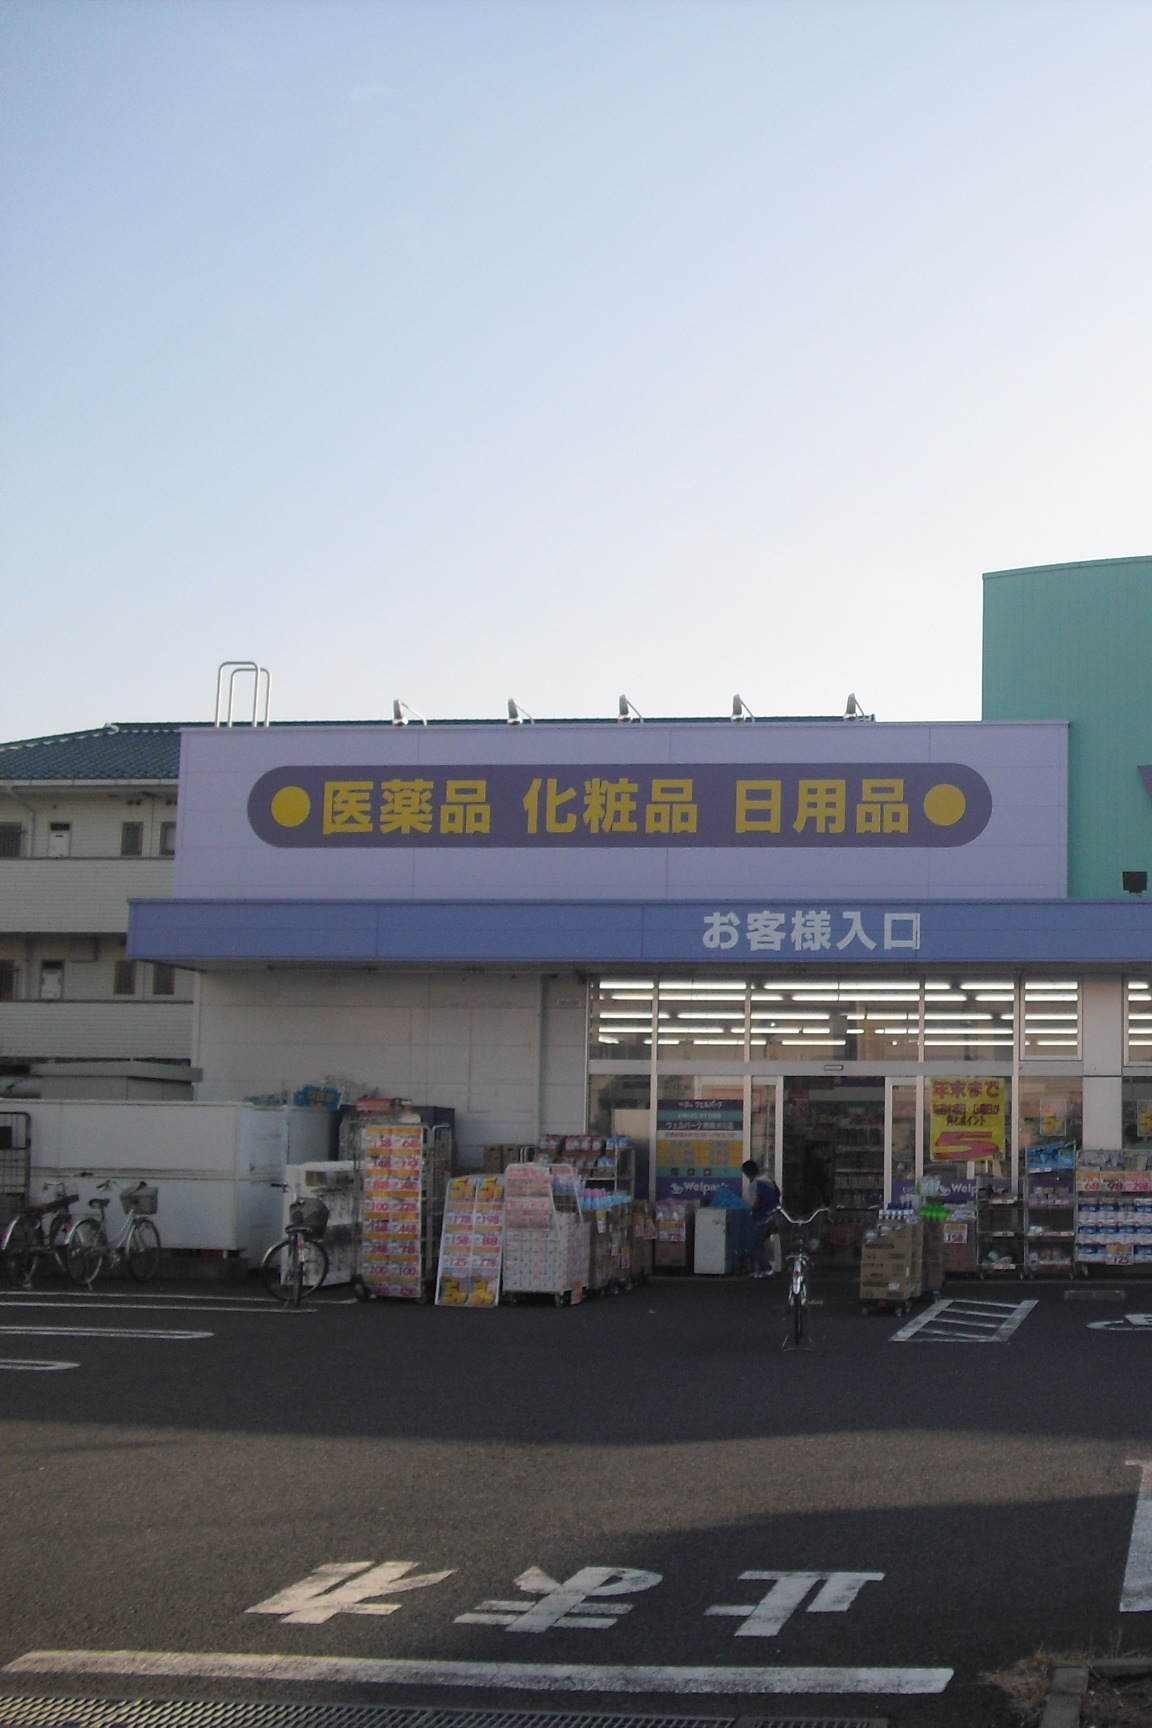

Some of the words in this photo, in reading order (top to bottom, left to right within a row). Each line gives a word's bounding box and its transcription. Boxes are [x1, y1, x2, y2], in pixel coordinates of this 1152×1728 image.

[321, 779, 490, 835] 医薬品
[523, 777, 698, 834] 化粧品
[735, 777, 910, 834] 日用品
[702, 910, 921, 953] お客様入口
[244, 1560, 886, 1638] 止まれ
